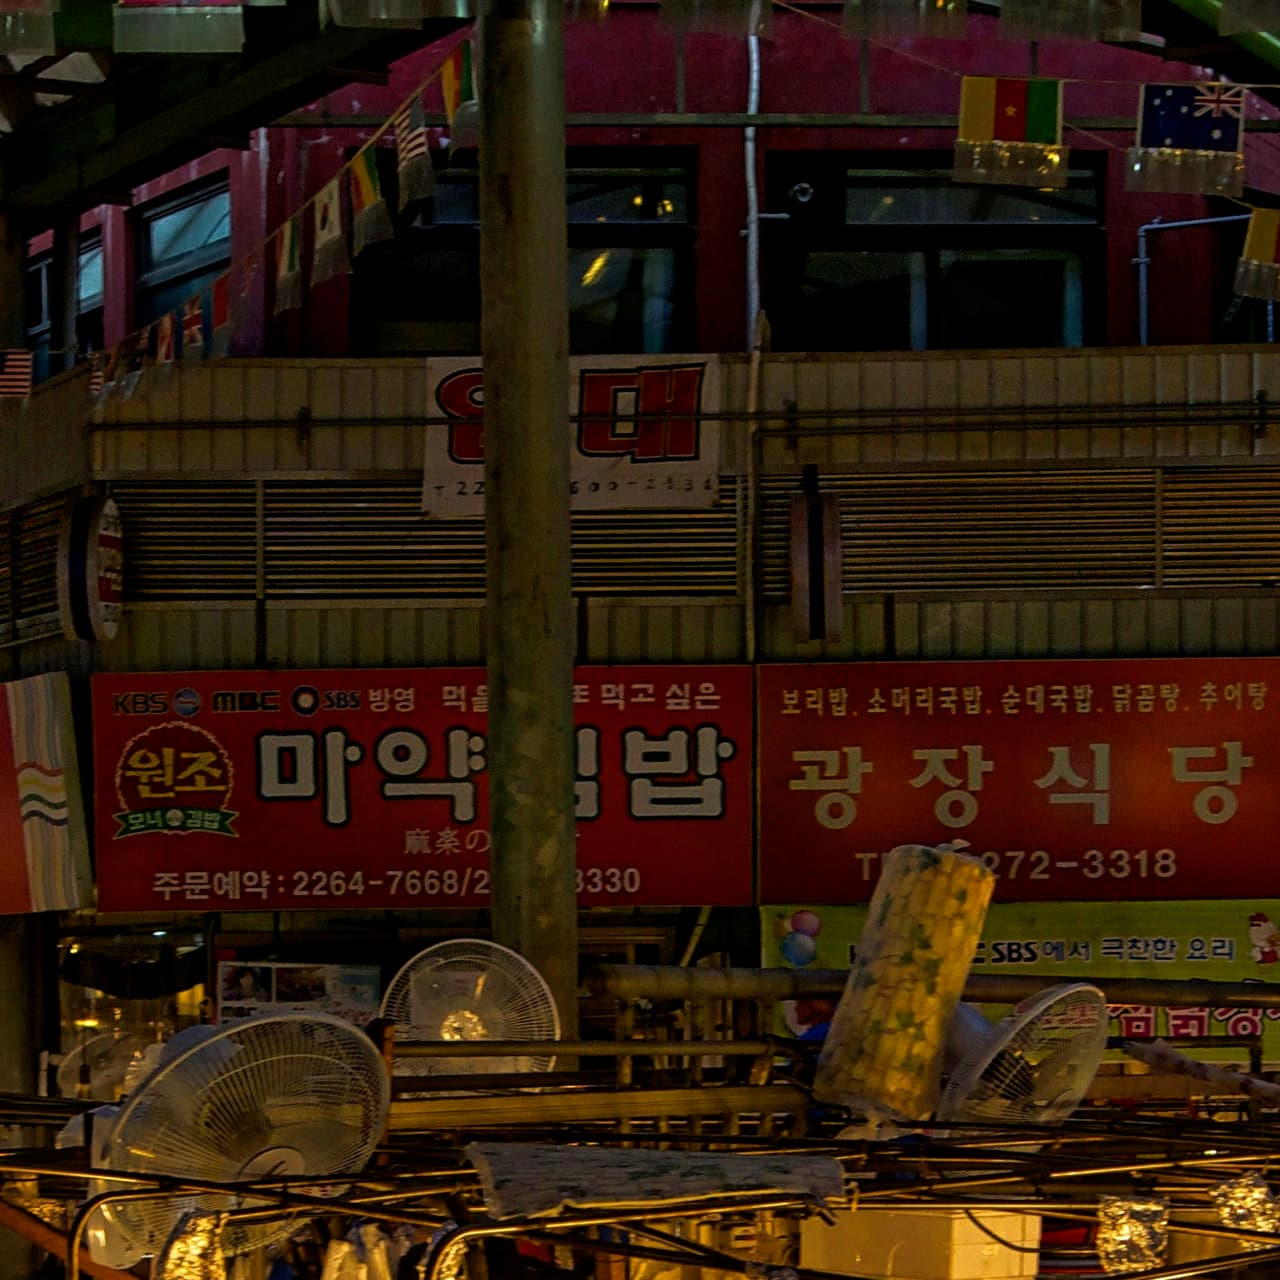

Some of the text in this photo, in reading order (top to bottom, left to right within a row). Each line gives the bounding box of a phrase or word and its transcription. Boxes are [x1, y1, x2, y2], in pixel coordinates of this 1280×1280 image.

[113, 692, 168, 716] KBS
[323, 690, 361, 710] SBS
[369, 686, 416, 713] 방영
[600, 683, 657, 712] 먹고
[665, 682, 722, 711] 싶은
[1200, 682, 1268, 711] 추어탕
[124, 746, 228, 799] 원조
[787, 740, 1256, 831] 광장식당
[978, 849, 1178, 881] 272-3318
[1101, 937, 1177, 962] 극찬한
[1186, 937, 1237, 962] 요리
